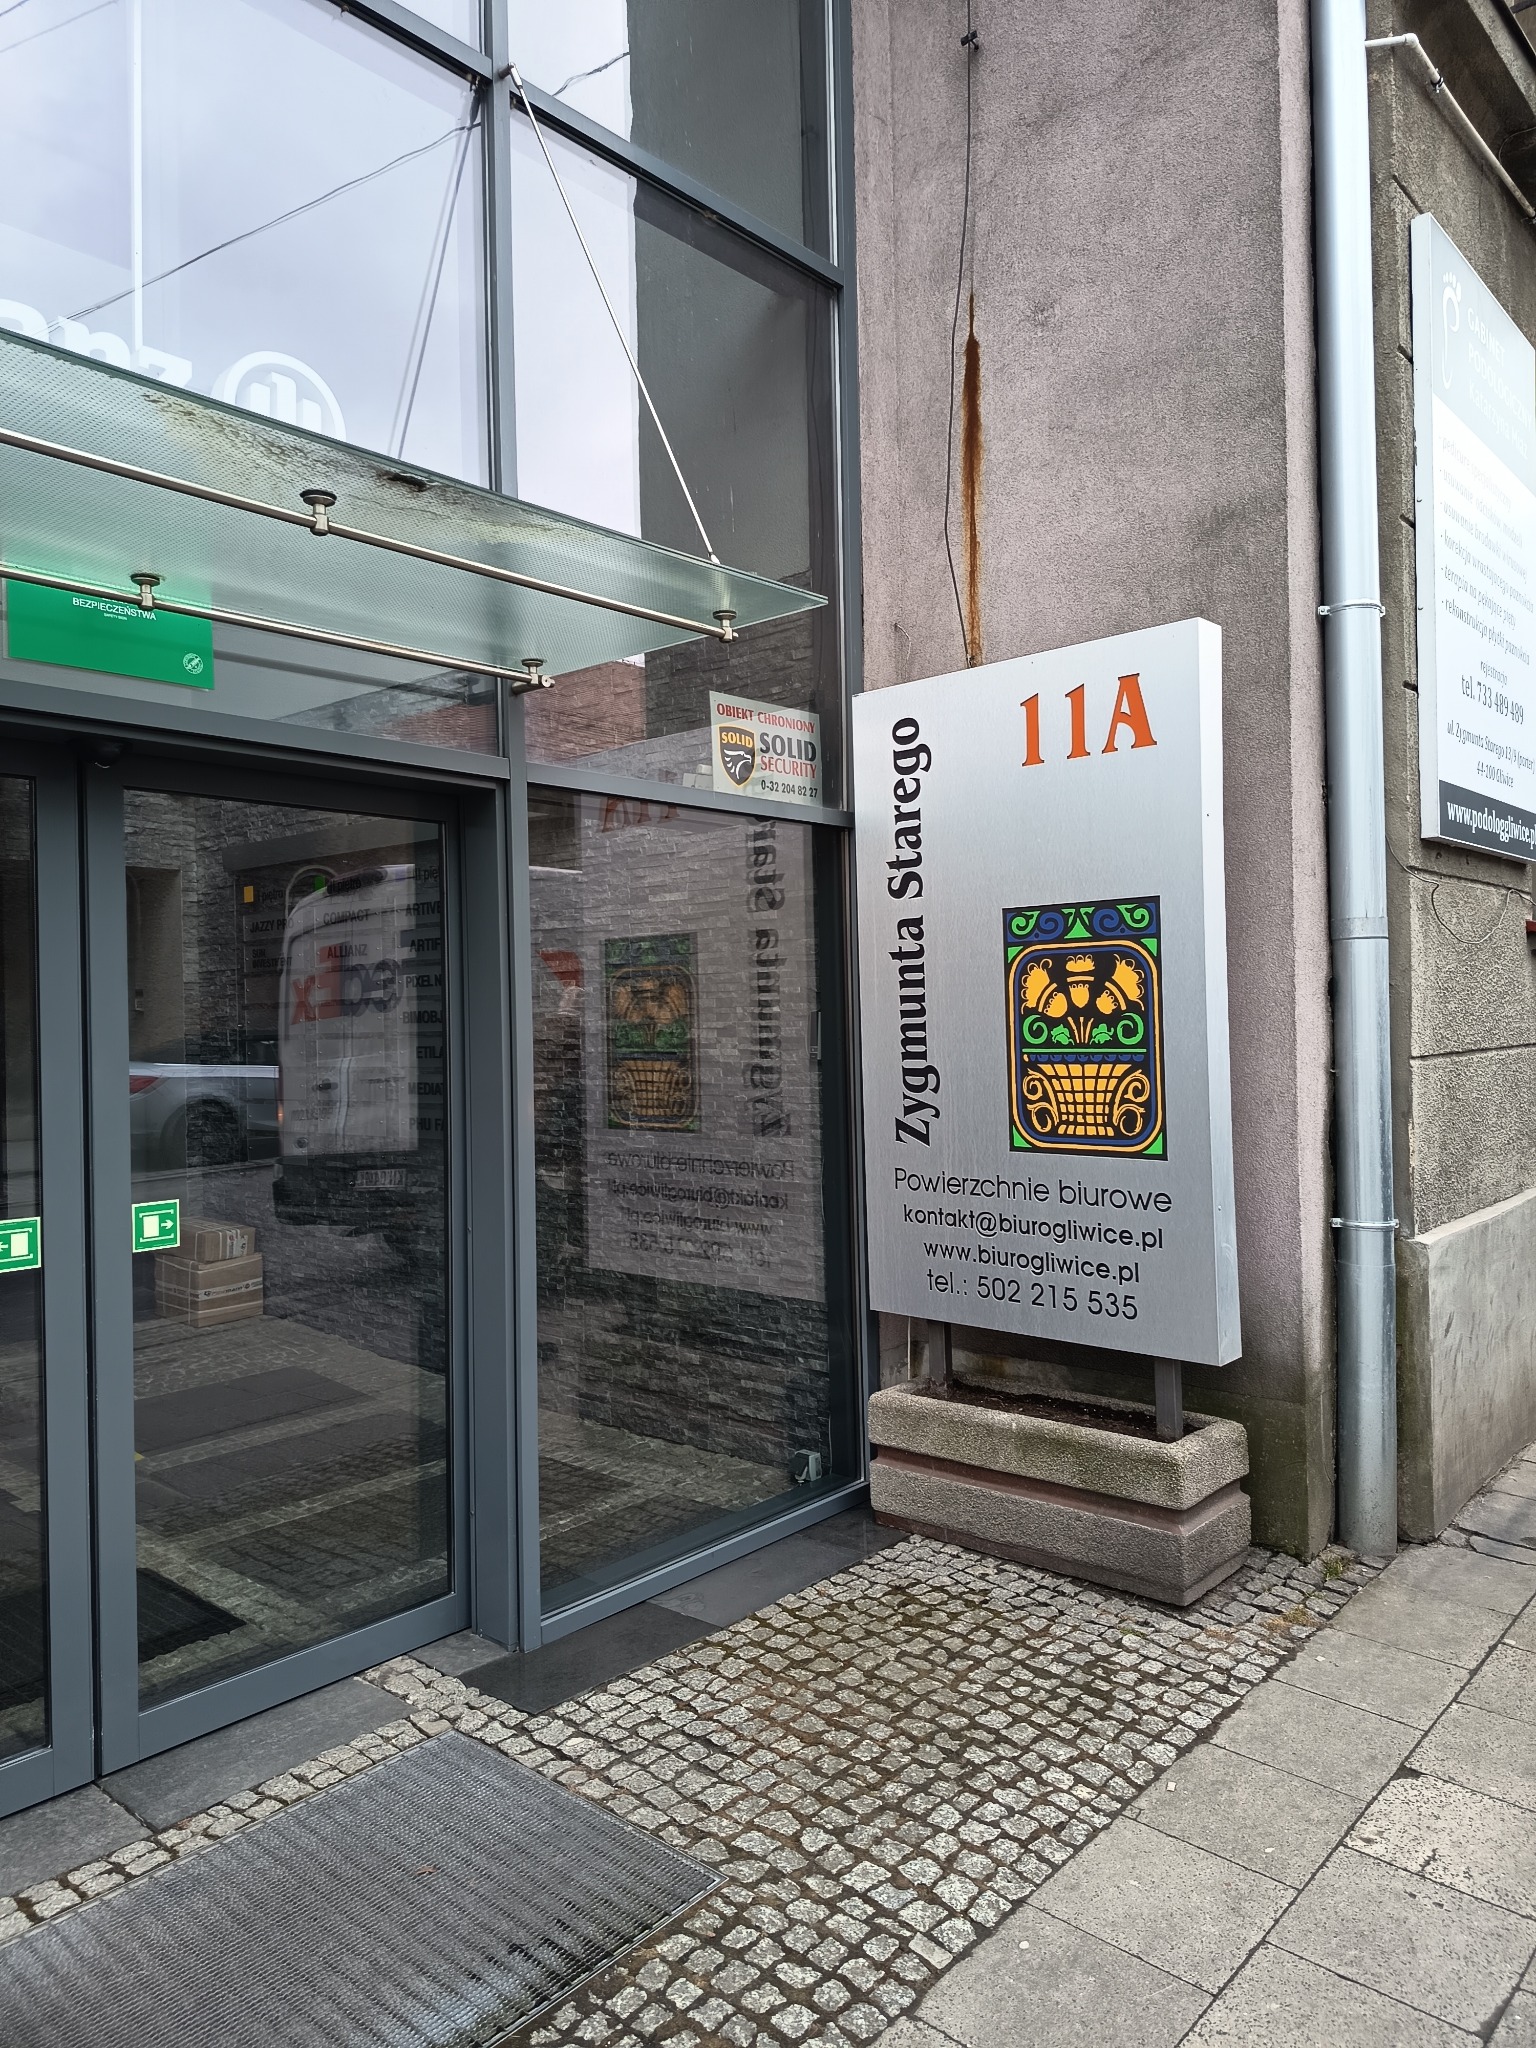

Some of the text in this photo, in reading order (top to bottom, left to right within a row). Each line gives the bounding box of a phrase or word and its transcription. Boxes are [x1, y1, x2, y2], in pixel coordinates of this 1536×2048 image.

[1467, 307, 1505, 367] GABINET
[1468, 342, 1533, 433] PODOLOGICZNY
[1469, 380, 1509, 437] Katarzyna
[1442, 437, 1470, 466] pedicure
[1443, 469, 1473, 504] usuwanie
[1444, 529, 1471, 566] korekcja
[1444, 564, 1468, 592] terapia
[1469, 584, 1477, 599] na
[72, 597, 156, 620] BEZPIECZEŃSTWA
[1445, 598, 1488, 639] rekonstrukcja
[1480, 660, 1508, 688] rejestracja
[1461, 675, 1524, 725] tel. 733 489 489
[717, 703, 815, 734] OBIEKT CHRONIONY
[1020, 672, 1158, 767] 11A
[721, 731, 754, 748] SOLID
[759, 732, 817, 762] SOLID
[1447, 720, 1455, 736] ul.
[1455, 722, 1484, 748] Zygmunta
[1485, 736, 1504, 760] Starego
[760, 755, 817, 780] SECURITY
[1477, 760, 1514, 788] 44-100 Gliwice
[761, 779, 819, 799] 0-32 204 82 27
[1447, 801, 1536, 850] www.podologgliwice.pl
[249, 919, 275, 933] JAZZY
[323, 909, 370, 925] COMPACT
[886, 716, 941, 1149] Zygmunta Starego
[327, 944, 368, 959] ALLIANZ
[894, 1167, 1173, 1213] Powierzchnie biurowe
[903, 1203, 1164, 1253] kontakt@biurogliwice.pl
[923, 1241, 1140, 1286] www.biurogliwice.pl
[927, 1268, 1139, 1320] tel.: 502 215 535
